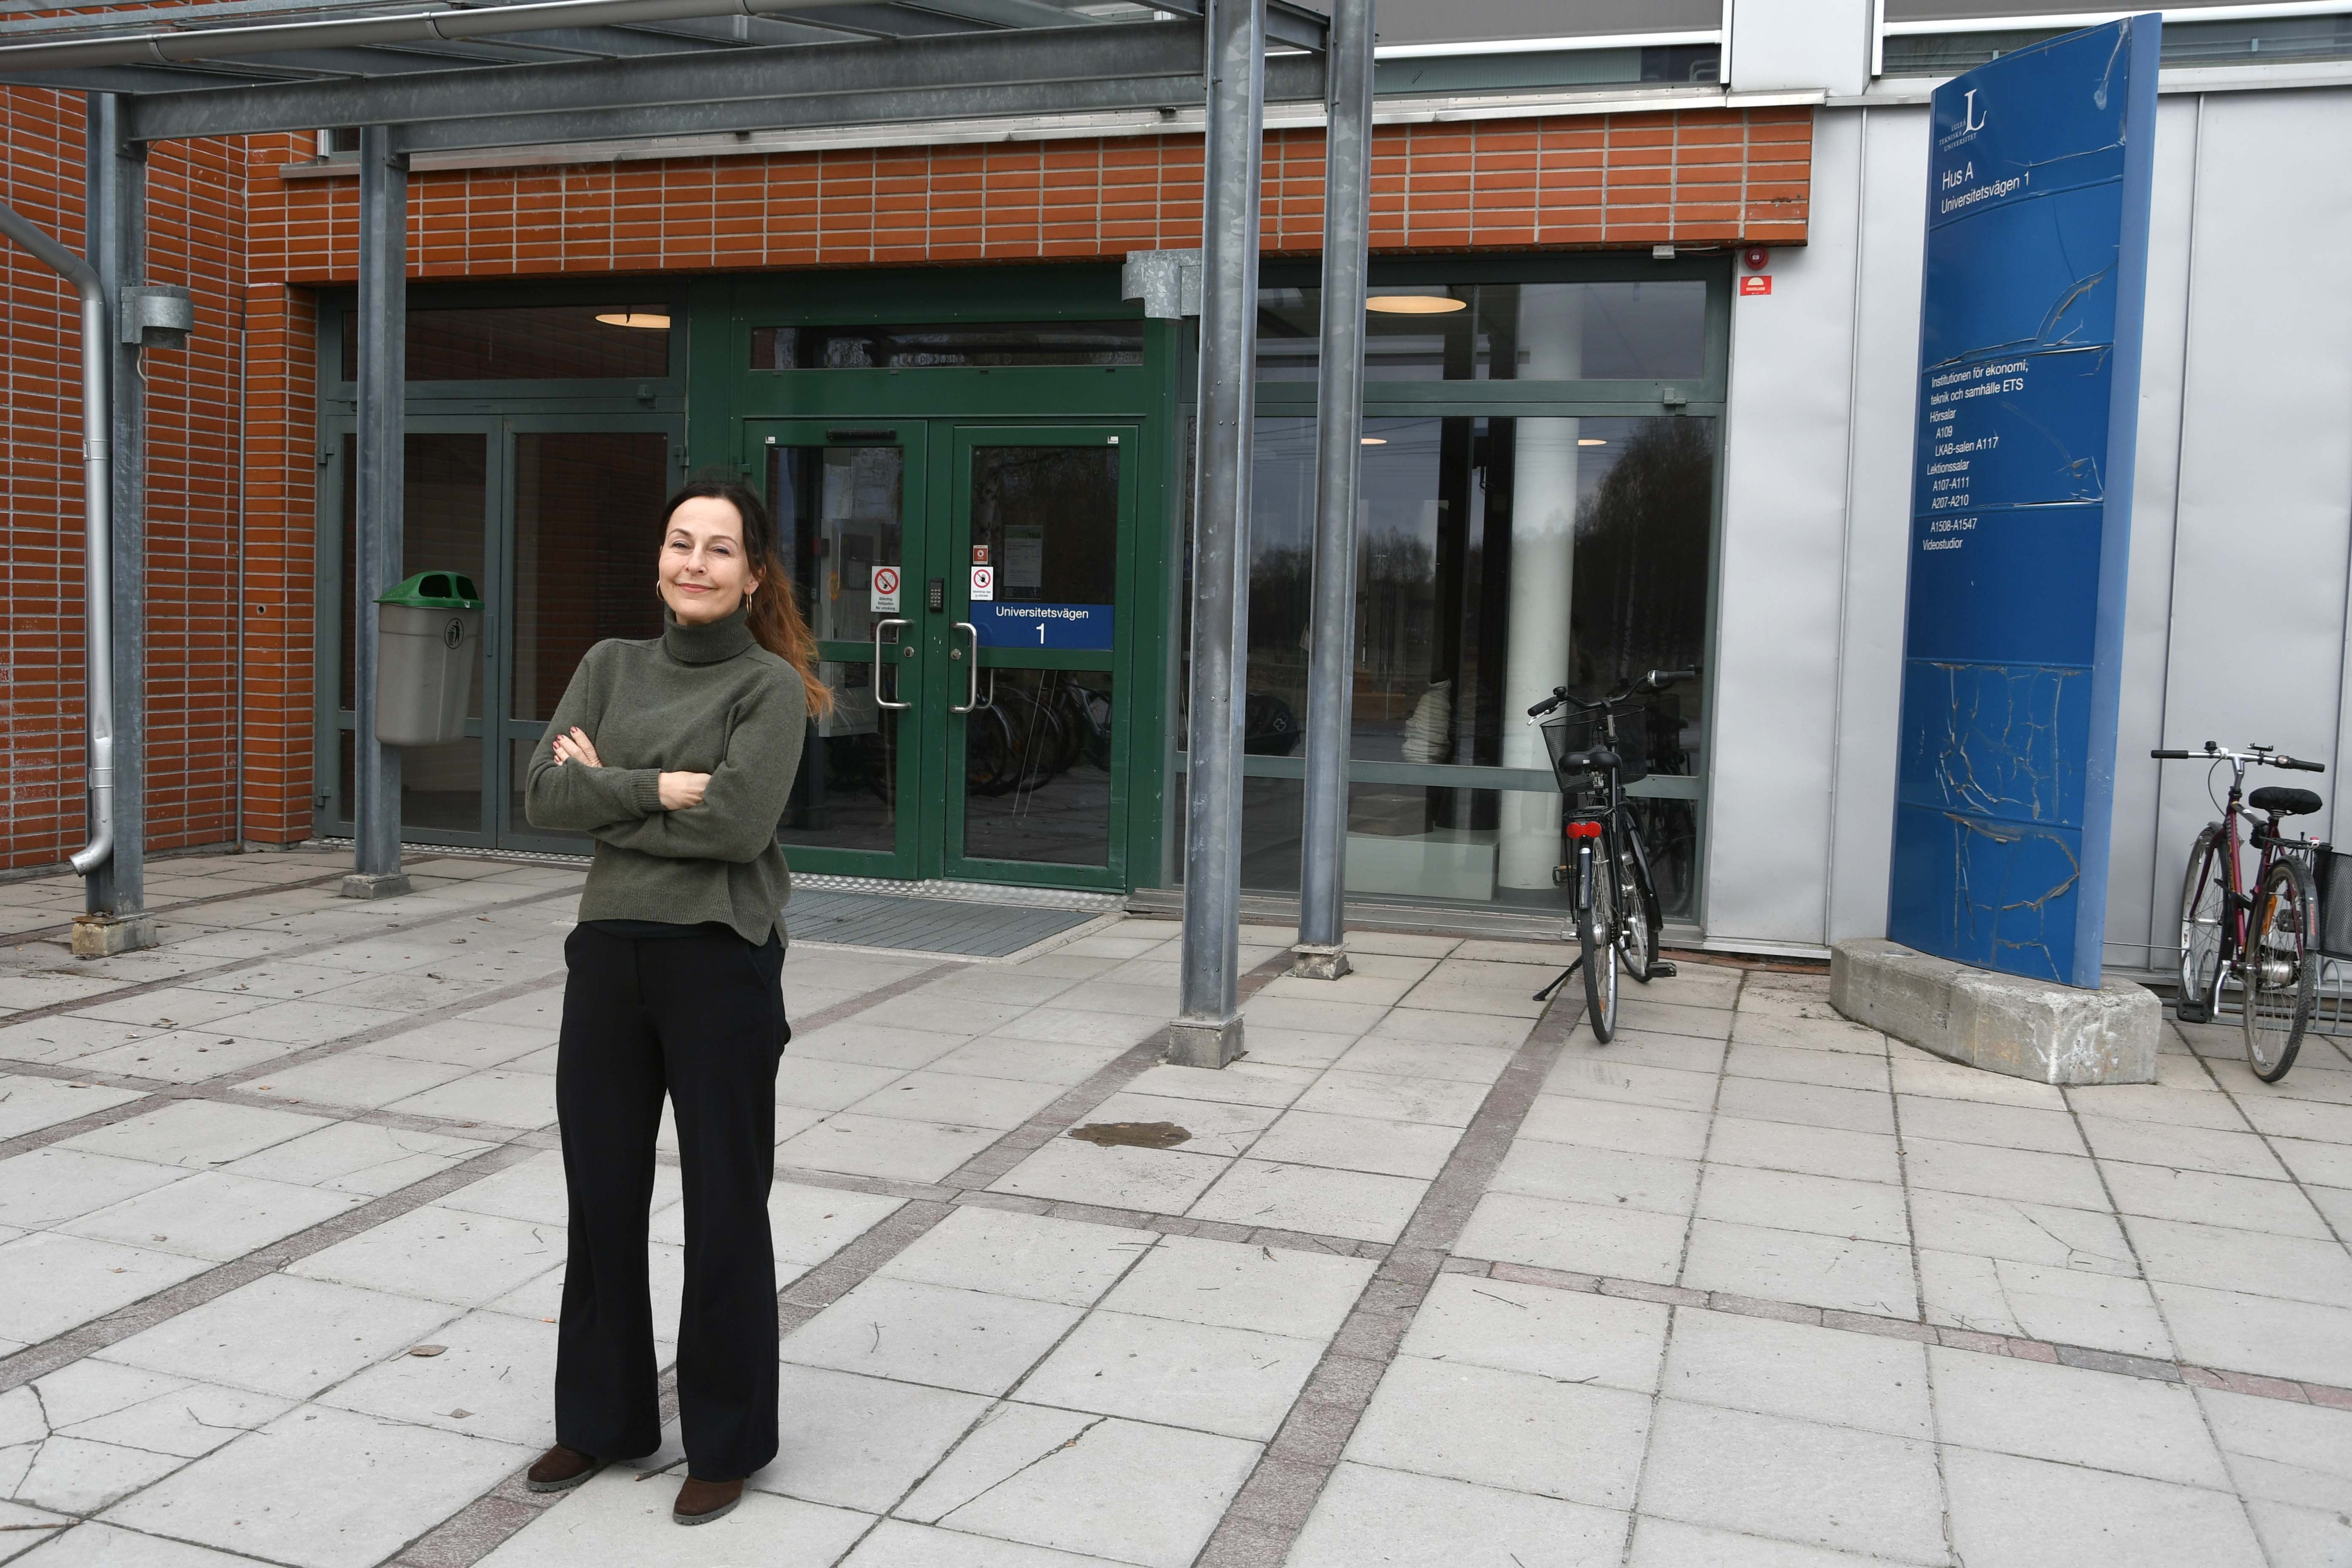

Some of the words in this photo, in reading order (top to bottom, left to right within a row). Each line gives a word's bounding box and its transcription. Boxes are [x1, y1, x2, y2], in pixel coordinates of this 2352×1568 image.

[1939, 131, 1962, 146] TEKNISKA
[1944, 132, 1977, 152] UNIVERSITET
[1942, 170, 1962, 191] Hus
[1965, 161, 1974, 181] A
[1941, 178, 2019, 214] Universitetsvägen
[2024, 171, 2029, 186] 1
[1932, 371, 1971, 388] Institutionen
[1973, 367, 1984, 379] för
[1985, 359, 2028, 376] ekonomi,
[1930, 391, 1949, 406] teknik
[1950, 387, 1963, 400] och
[1965, 382, 2000, 398] samhälle
[2003, 378, 2023, 393] ETS
[1930, 408, 1956, 423] Hörsalar
[1936, 426, 1953, 439] A109
[1935, 441, 1974, 457] LKAB-salen
[1976, 437, 1998, 450] A117
[1927, 460, 1970, 475] Lektionssalar
[1933, 477, 1969, 492] A107-A111
[1931, 494, 1968, 509] A207-A210
[1930, 518, 1977, 533] A1508-A1547
[1922, 538, 1963, 550] Videostudior
[996, 606, 1089, 621] Universitetsvägen
[1036, 623, 1044, 644] 1
